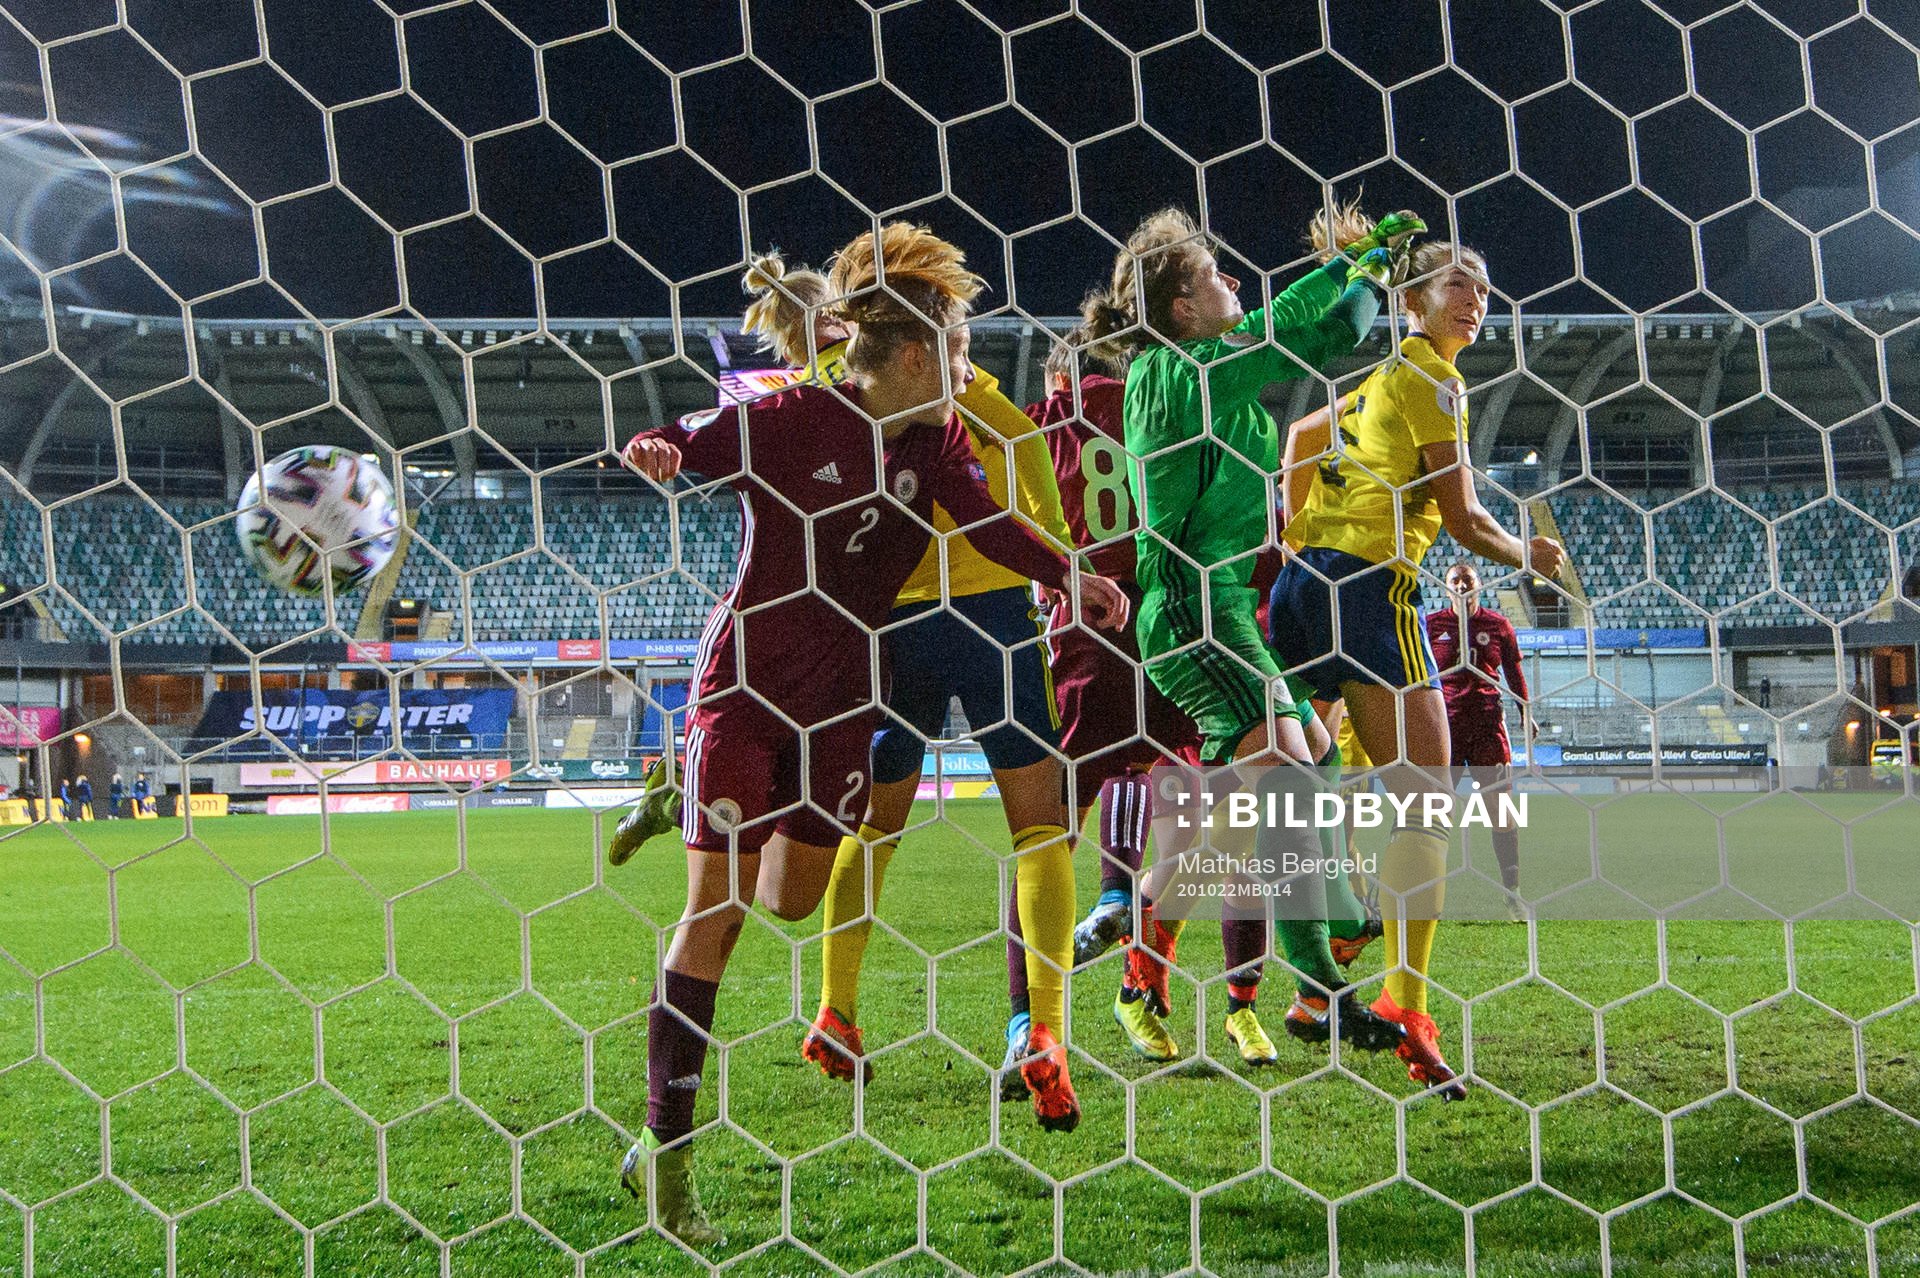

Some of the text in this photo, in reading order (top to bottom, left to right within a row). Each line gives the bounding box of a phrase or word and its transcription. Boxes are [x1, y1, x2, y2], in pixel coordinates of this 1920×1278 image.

[812, 472, 842, 484] adidas
[1081, 436, 1129, 541] 8
[845, 507, 880, 552] 2
[240, 703, 473, 730] SUPPRTER
[1562, 752, 1594, 761] Gamla
[1595, 751, 1623, 760] Ullevi
[1626, 751, 1657, 760] Gaml
[1660, 751, 1686, 760] Ullevi
[1690, 750, 1722, 760] Gamla
[1723, 750, 1751, 760] Ullevi
[390, 764, 497, 779] BAUHAUS
[591, 760, 629, 778] Carlsberg
[837, 771, 864, 821] 2
